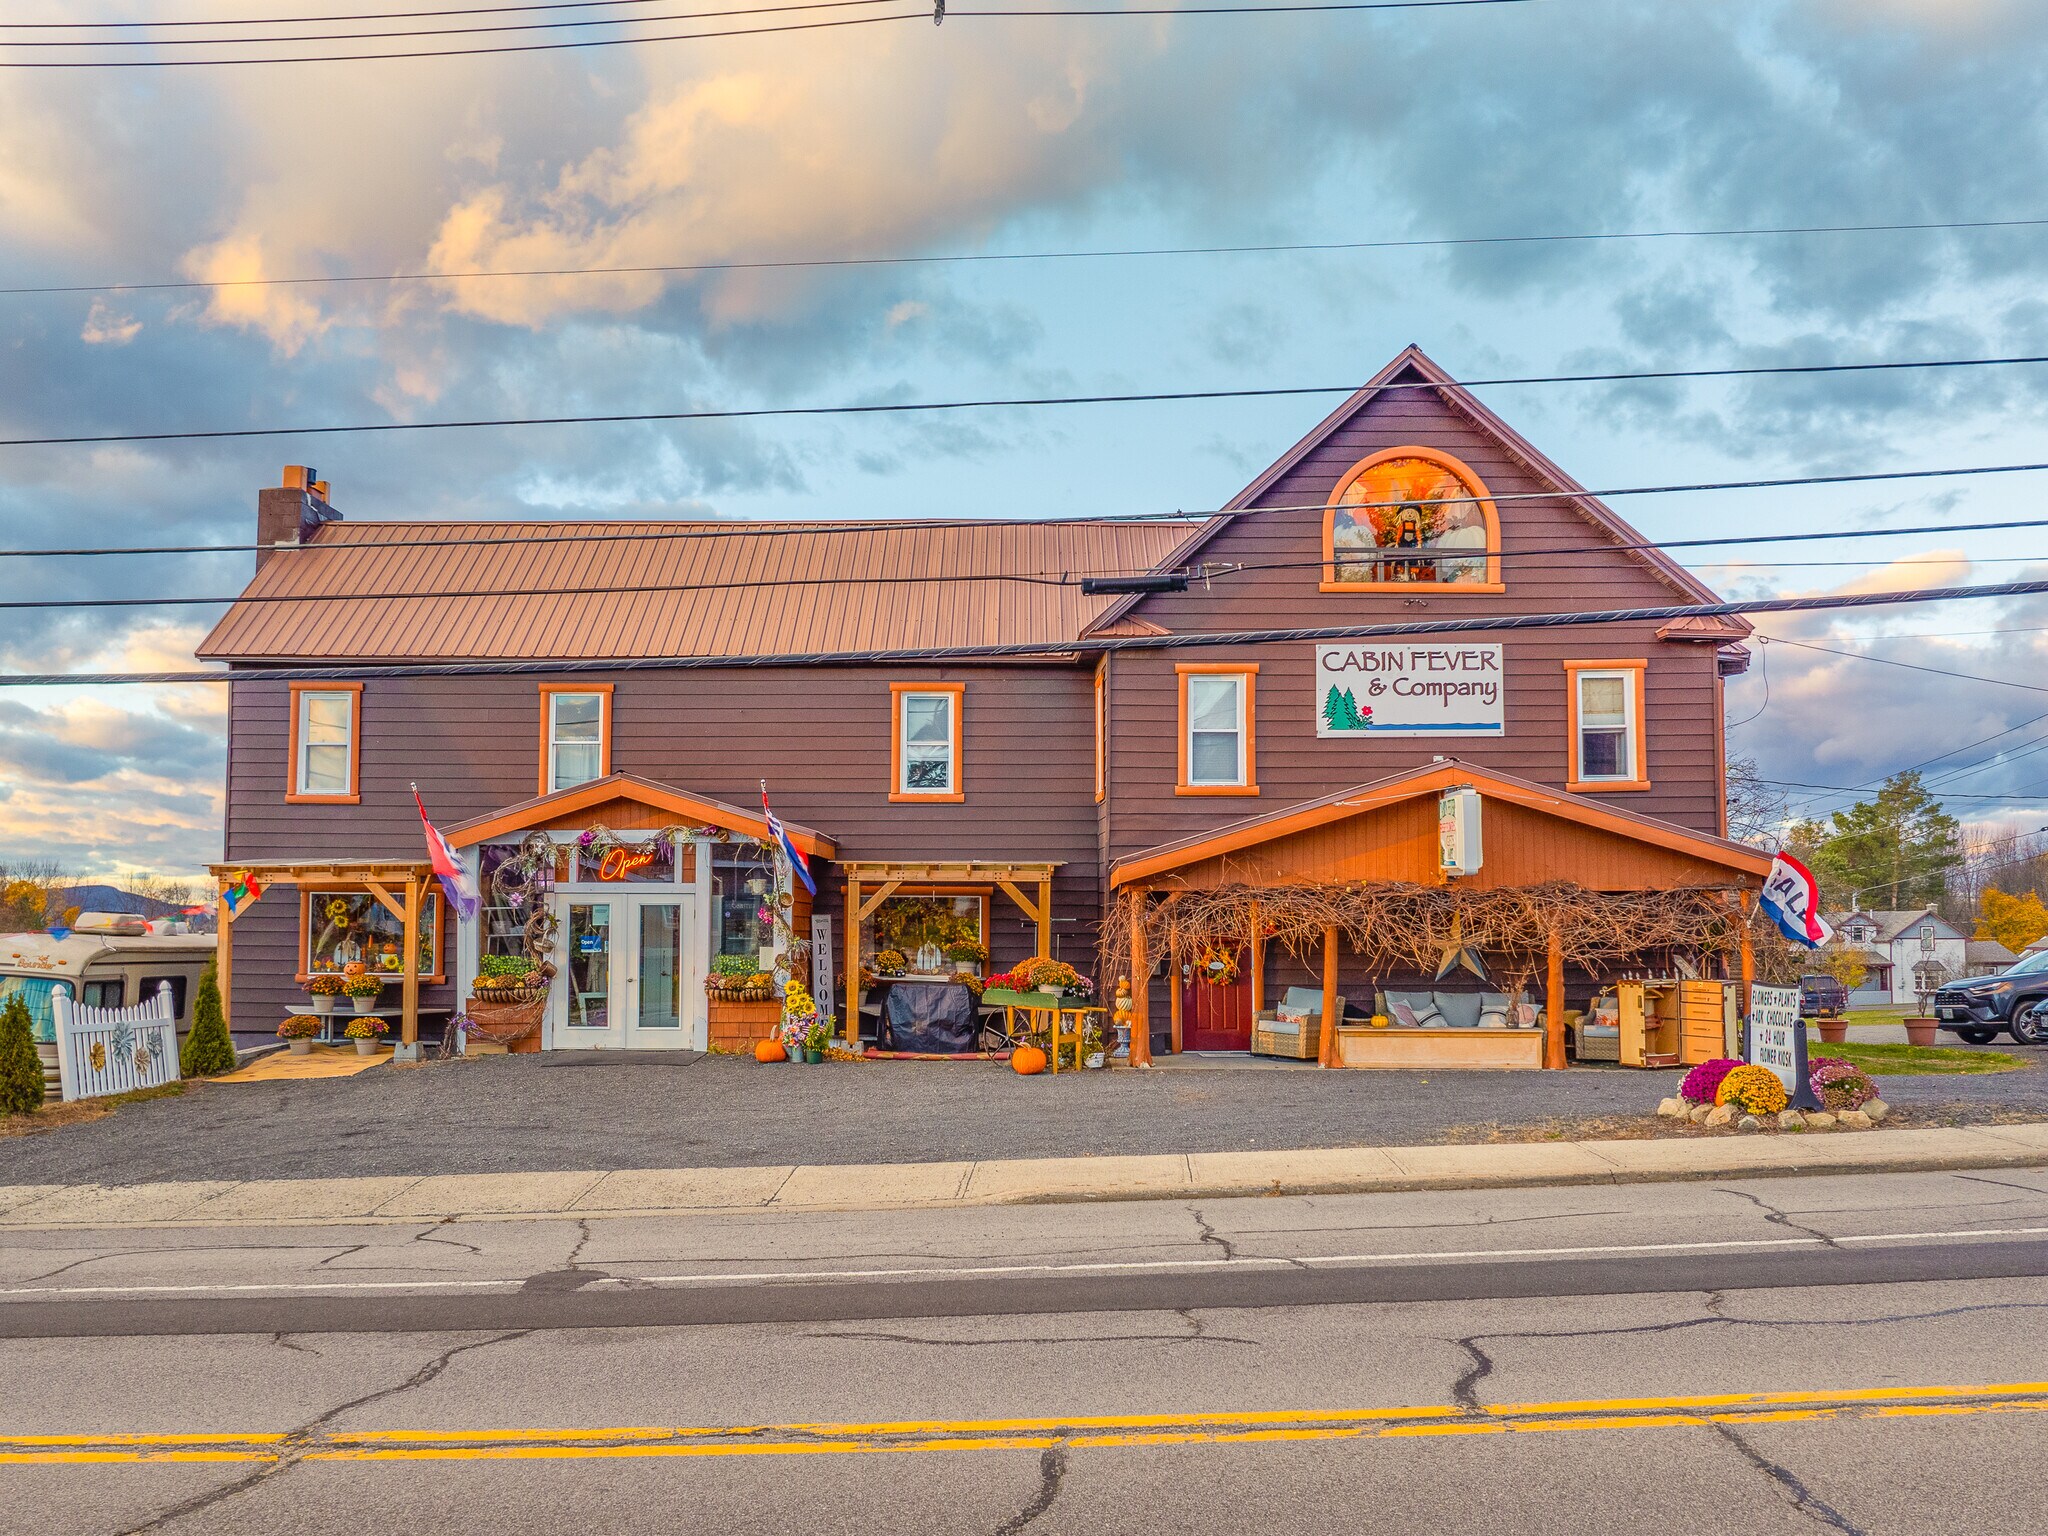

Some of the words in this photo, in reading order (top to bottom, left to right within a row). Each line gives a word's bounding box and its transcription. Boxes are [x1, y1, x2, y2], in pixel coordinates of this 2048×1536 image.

[1322, 651, 1404, 672] CABIN
[1411, 651, 1499, 671] FEVER
[1368, 677, 1388, 696] &
[1392, 677, 1497, 707] Company
[601, 849, 653, 879] Open
[1752, 990, 1773, 1006] FLOWERS
[1778, 991, 1797, 1008] PLANTS
[1766, 1010, 1793, 1028] CHOCOLATE
[1765, 1029, 1772, 1044] 24
[1773, 1030, 1785, 1046] HOUR
